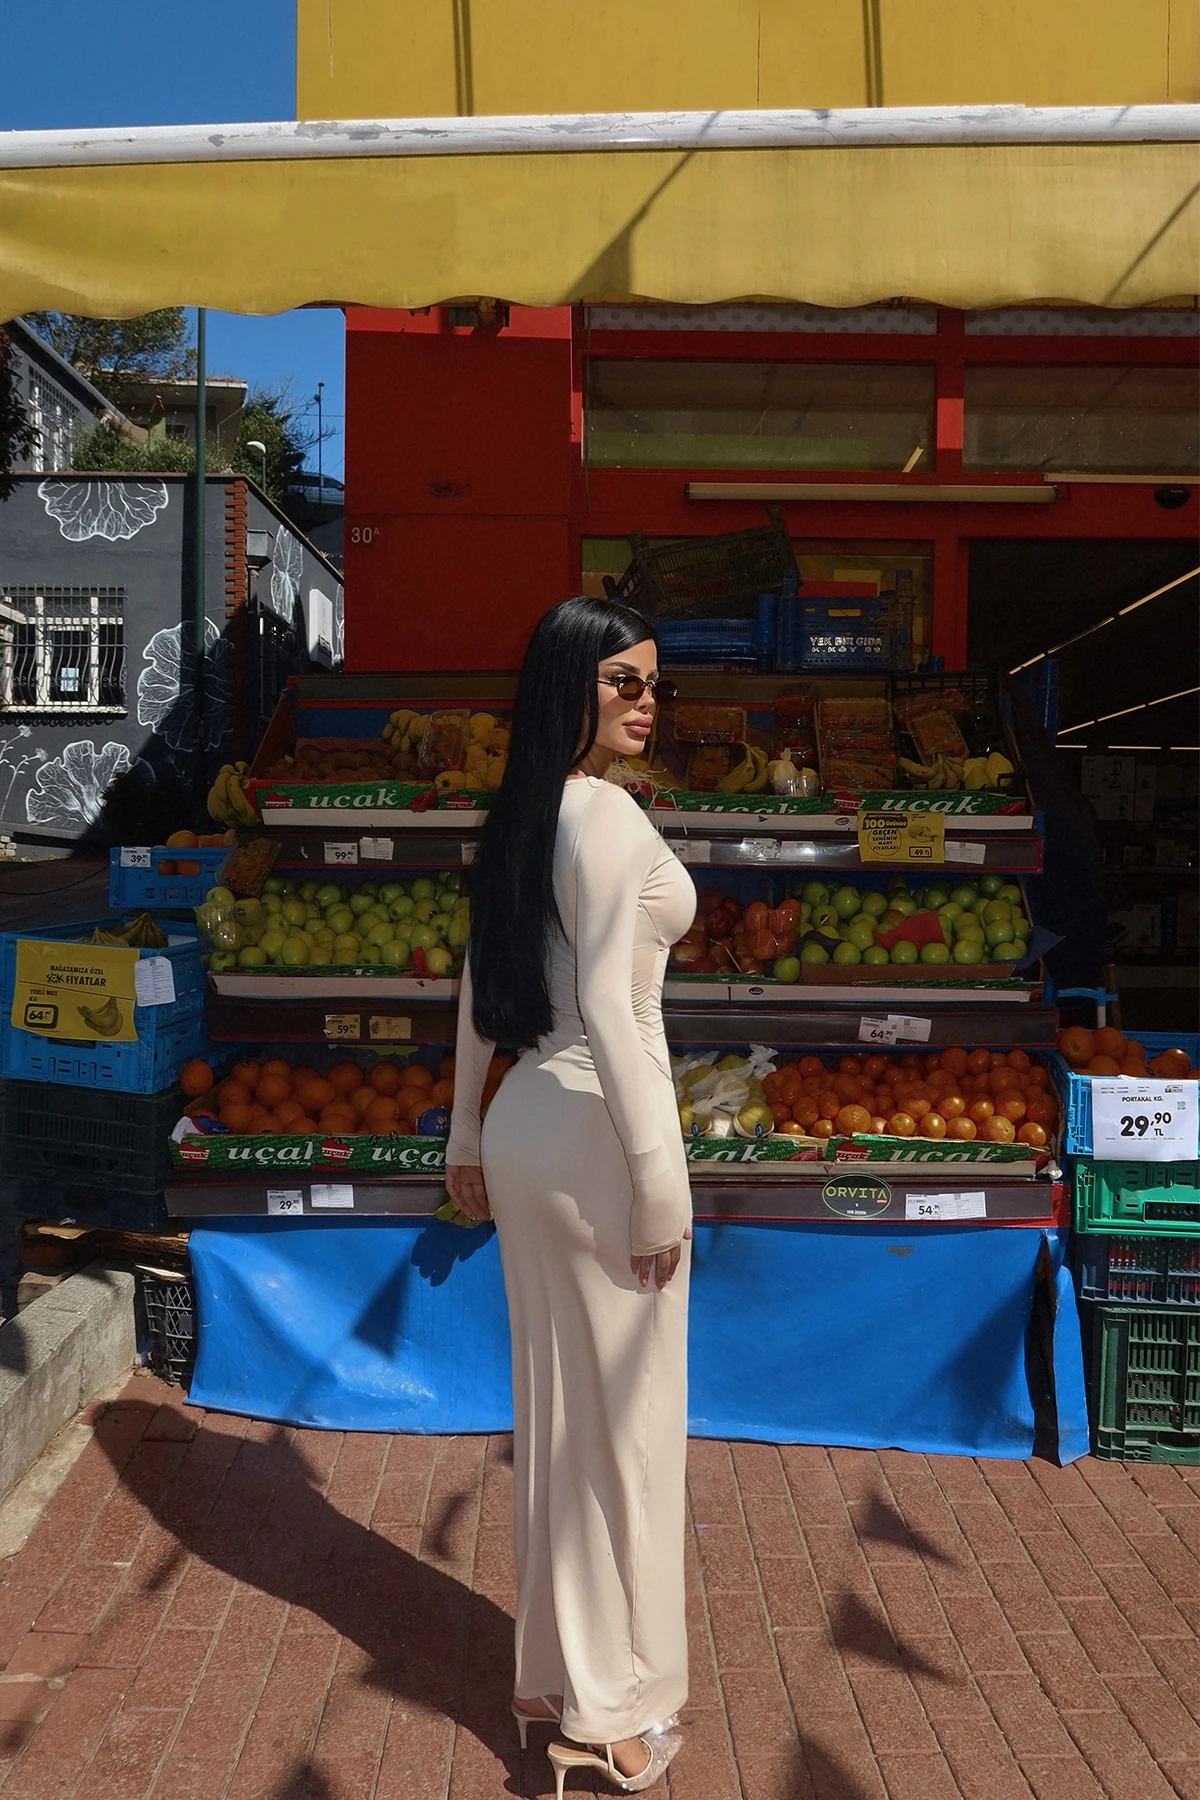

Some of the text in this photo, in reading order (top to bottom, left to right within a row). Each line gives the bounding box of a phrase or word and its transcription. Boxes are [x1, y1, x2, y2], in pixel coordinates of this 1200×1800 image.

[864, 819, 885, 829] 100
[66, 973, 107, 987] FİYATLAR
[1120, 1112, 1172, 1137] 29,90 TL
[371, 1147, 445, 1169] uça
[826, 1186, 887, 1199] ORVITA
